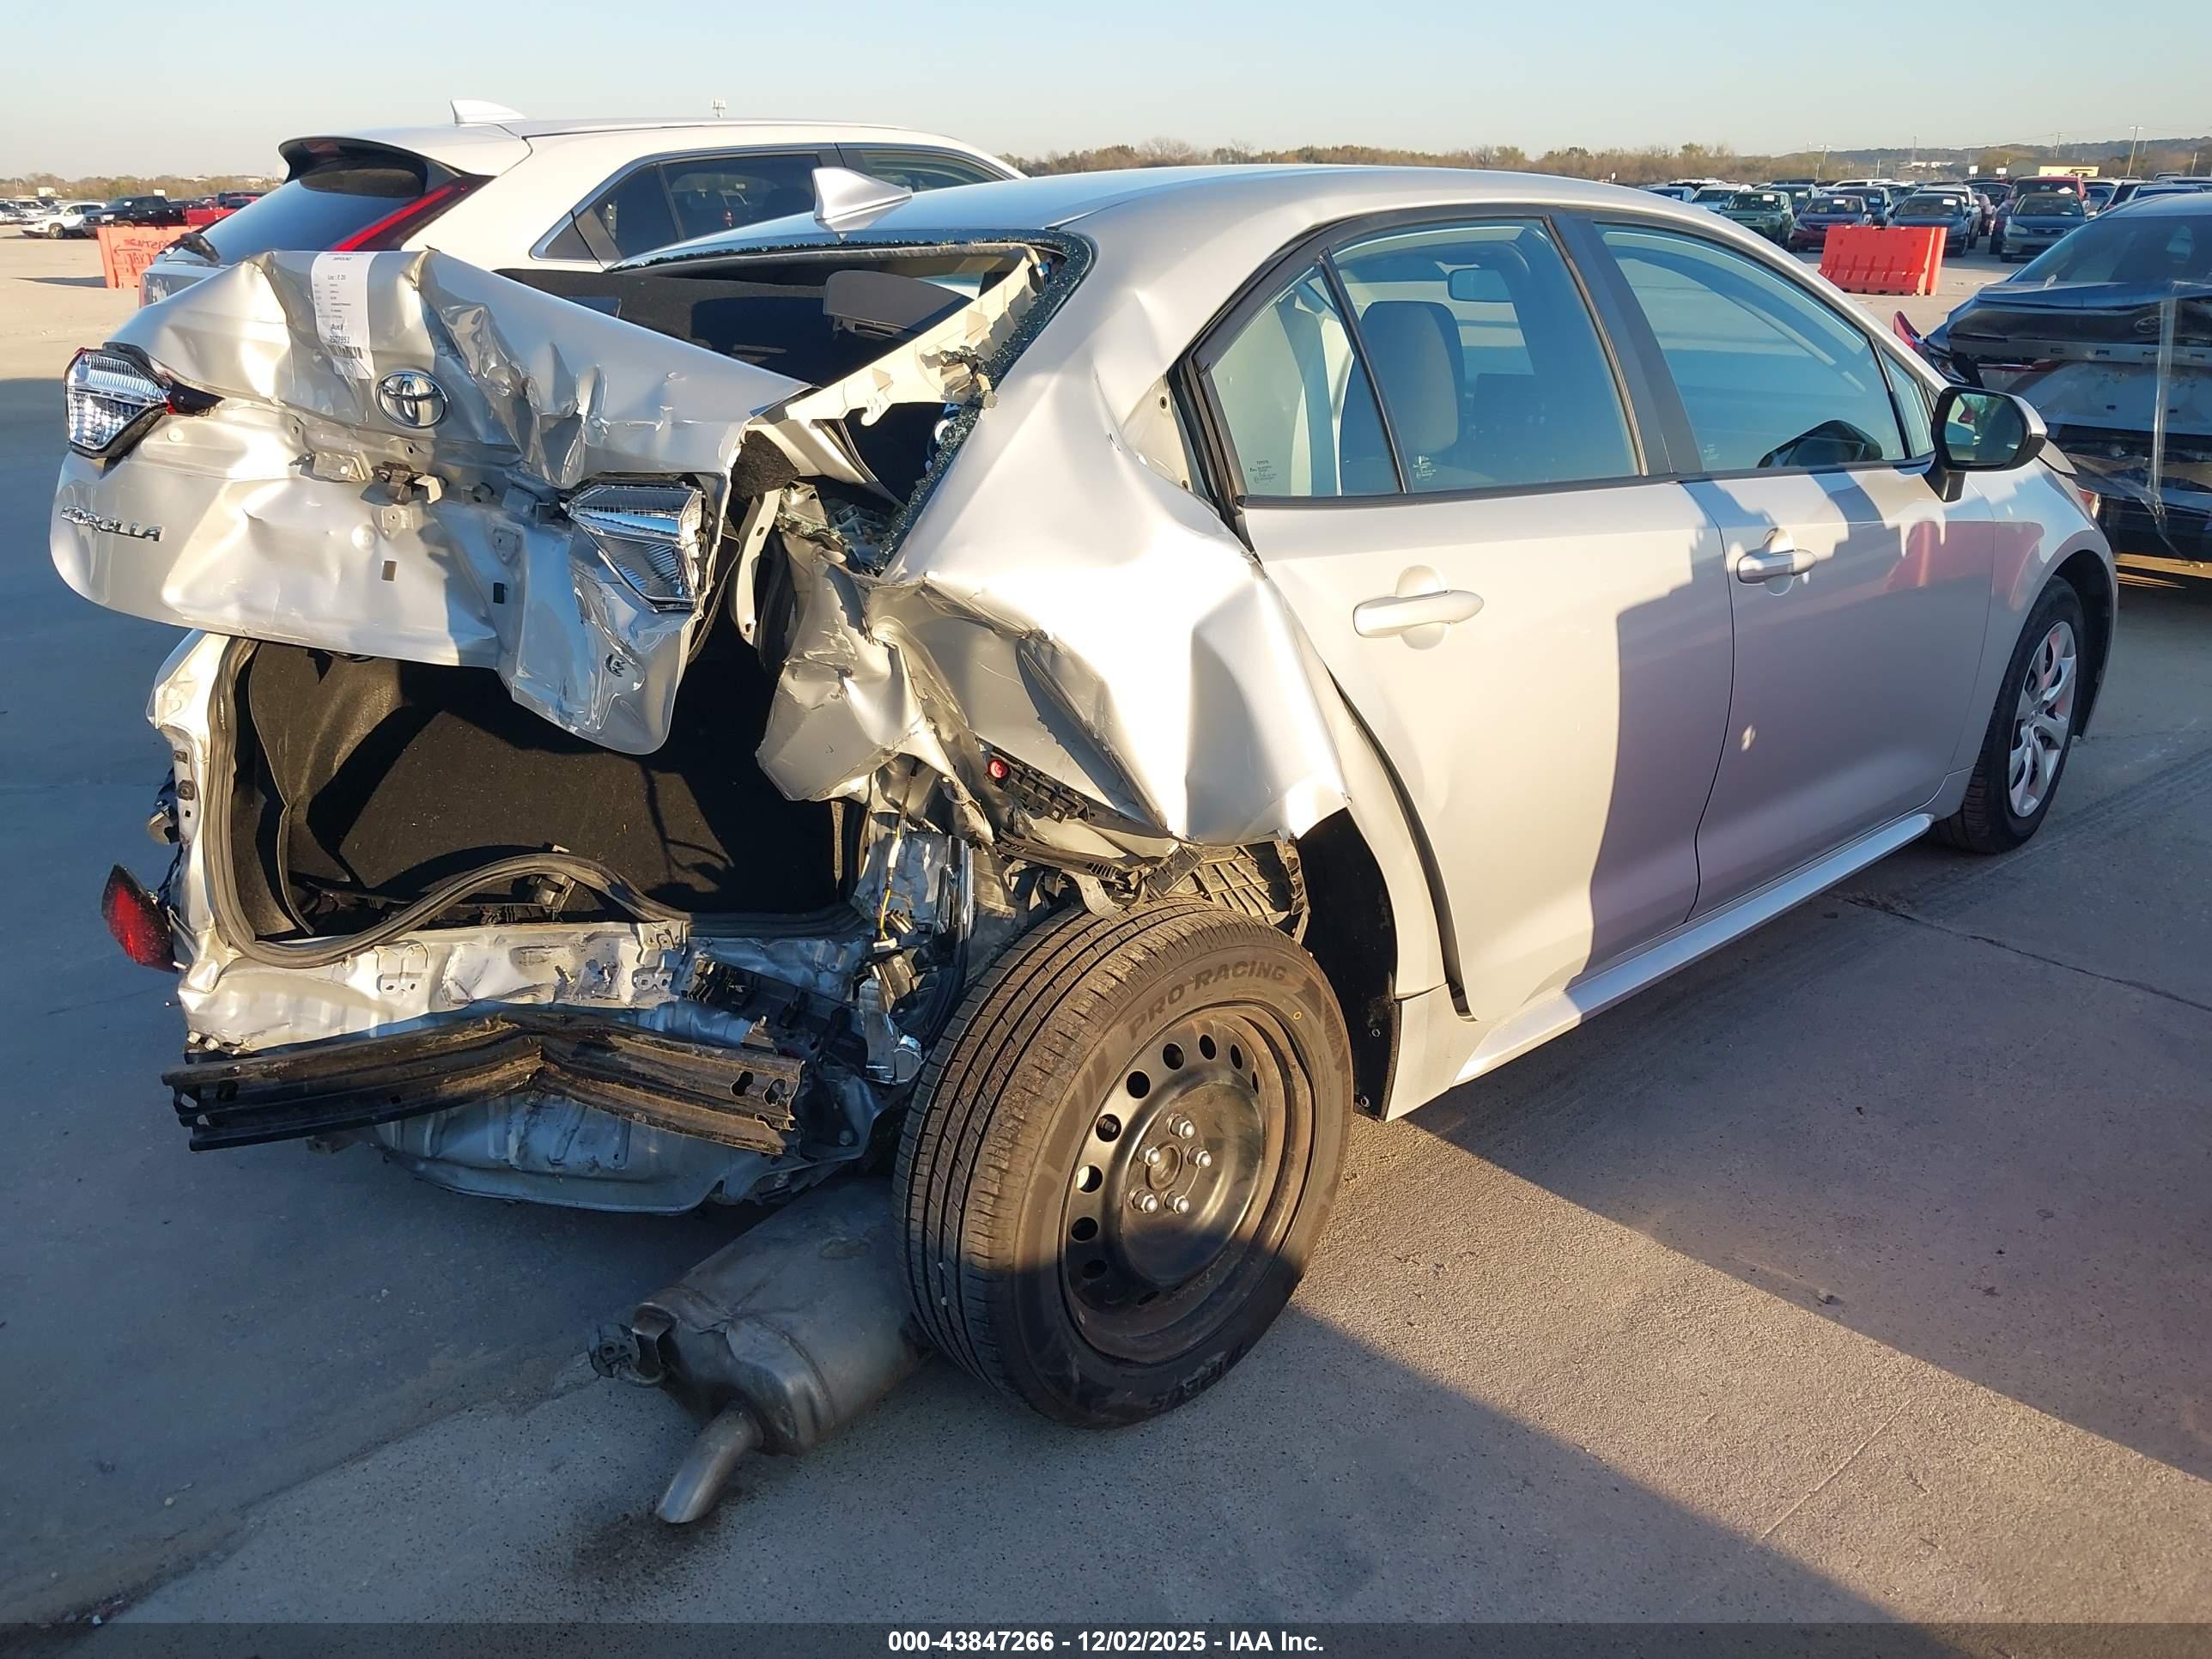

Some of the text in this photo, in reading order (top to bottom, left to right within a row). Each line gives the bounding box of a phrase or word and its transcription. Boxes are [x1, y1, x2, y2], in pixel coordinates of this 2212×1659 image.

[61, 505, 165, 542] COROLLA
[1127, 961, 1287, 1040] PRO RACING
